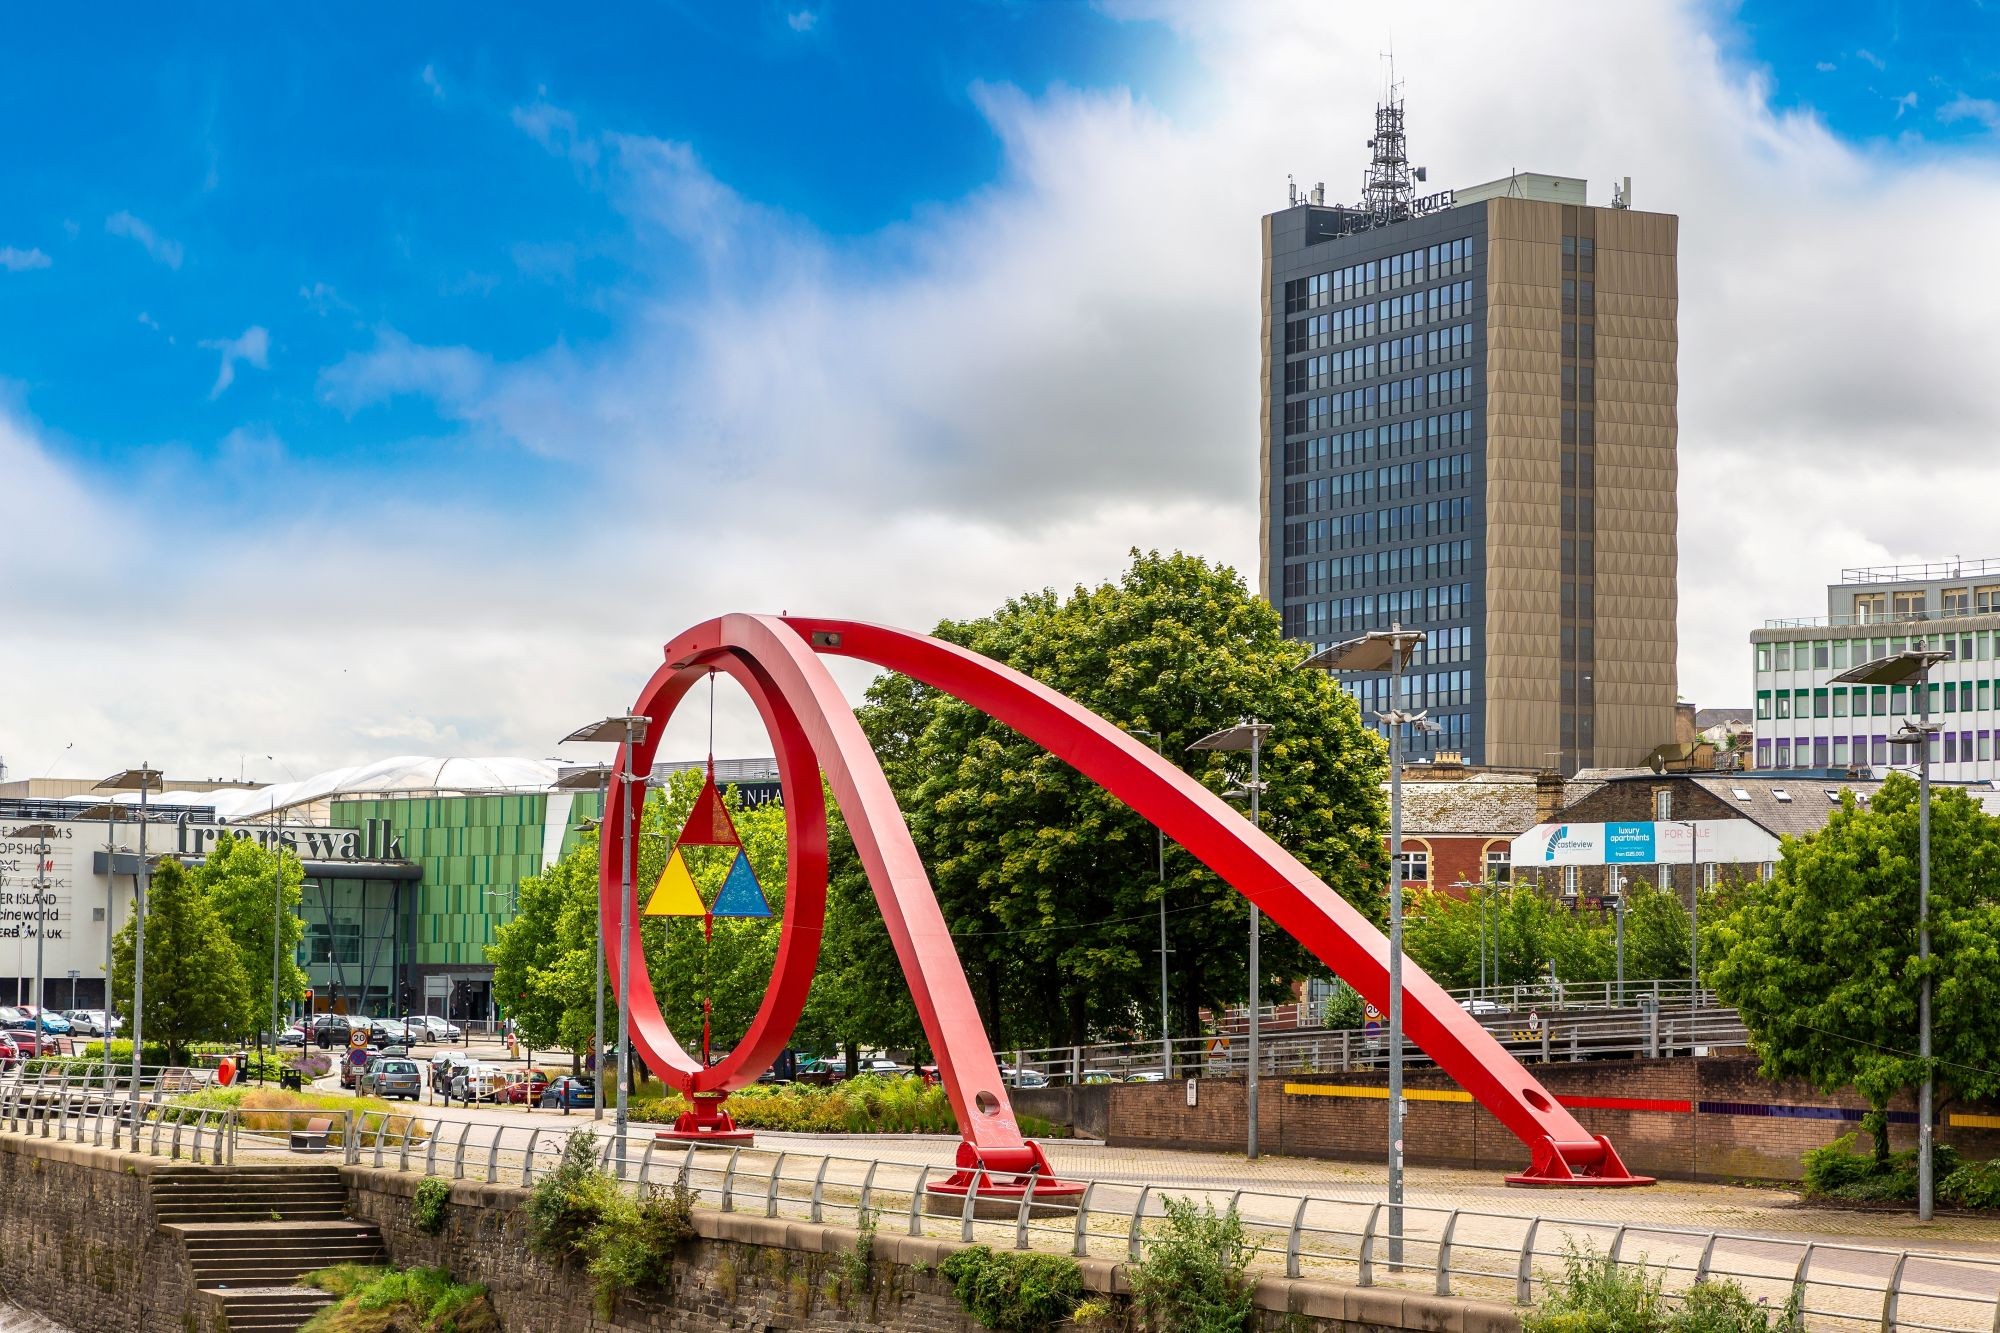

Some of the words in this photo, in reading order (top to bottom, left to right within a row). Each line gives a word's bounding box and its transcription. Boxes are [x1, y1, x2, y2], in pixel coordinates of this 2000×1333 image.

[1412, 190, 1457, 215] HOTEL
[1618, 827, 1640, 836] luxury
[1664, 829, 1684, 839] FOR
[302, 818, 405, 860] walk
[1557, 840, 1593, 848] castleview
[1610, 834, 1650, 844] apartments
[16, 893, 57, 905] ISLAND
[0, 908, 59, 921] cineworld
[47, 929, 62, 939] UK
